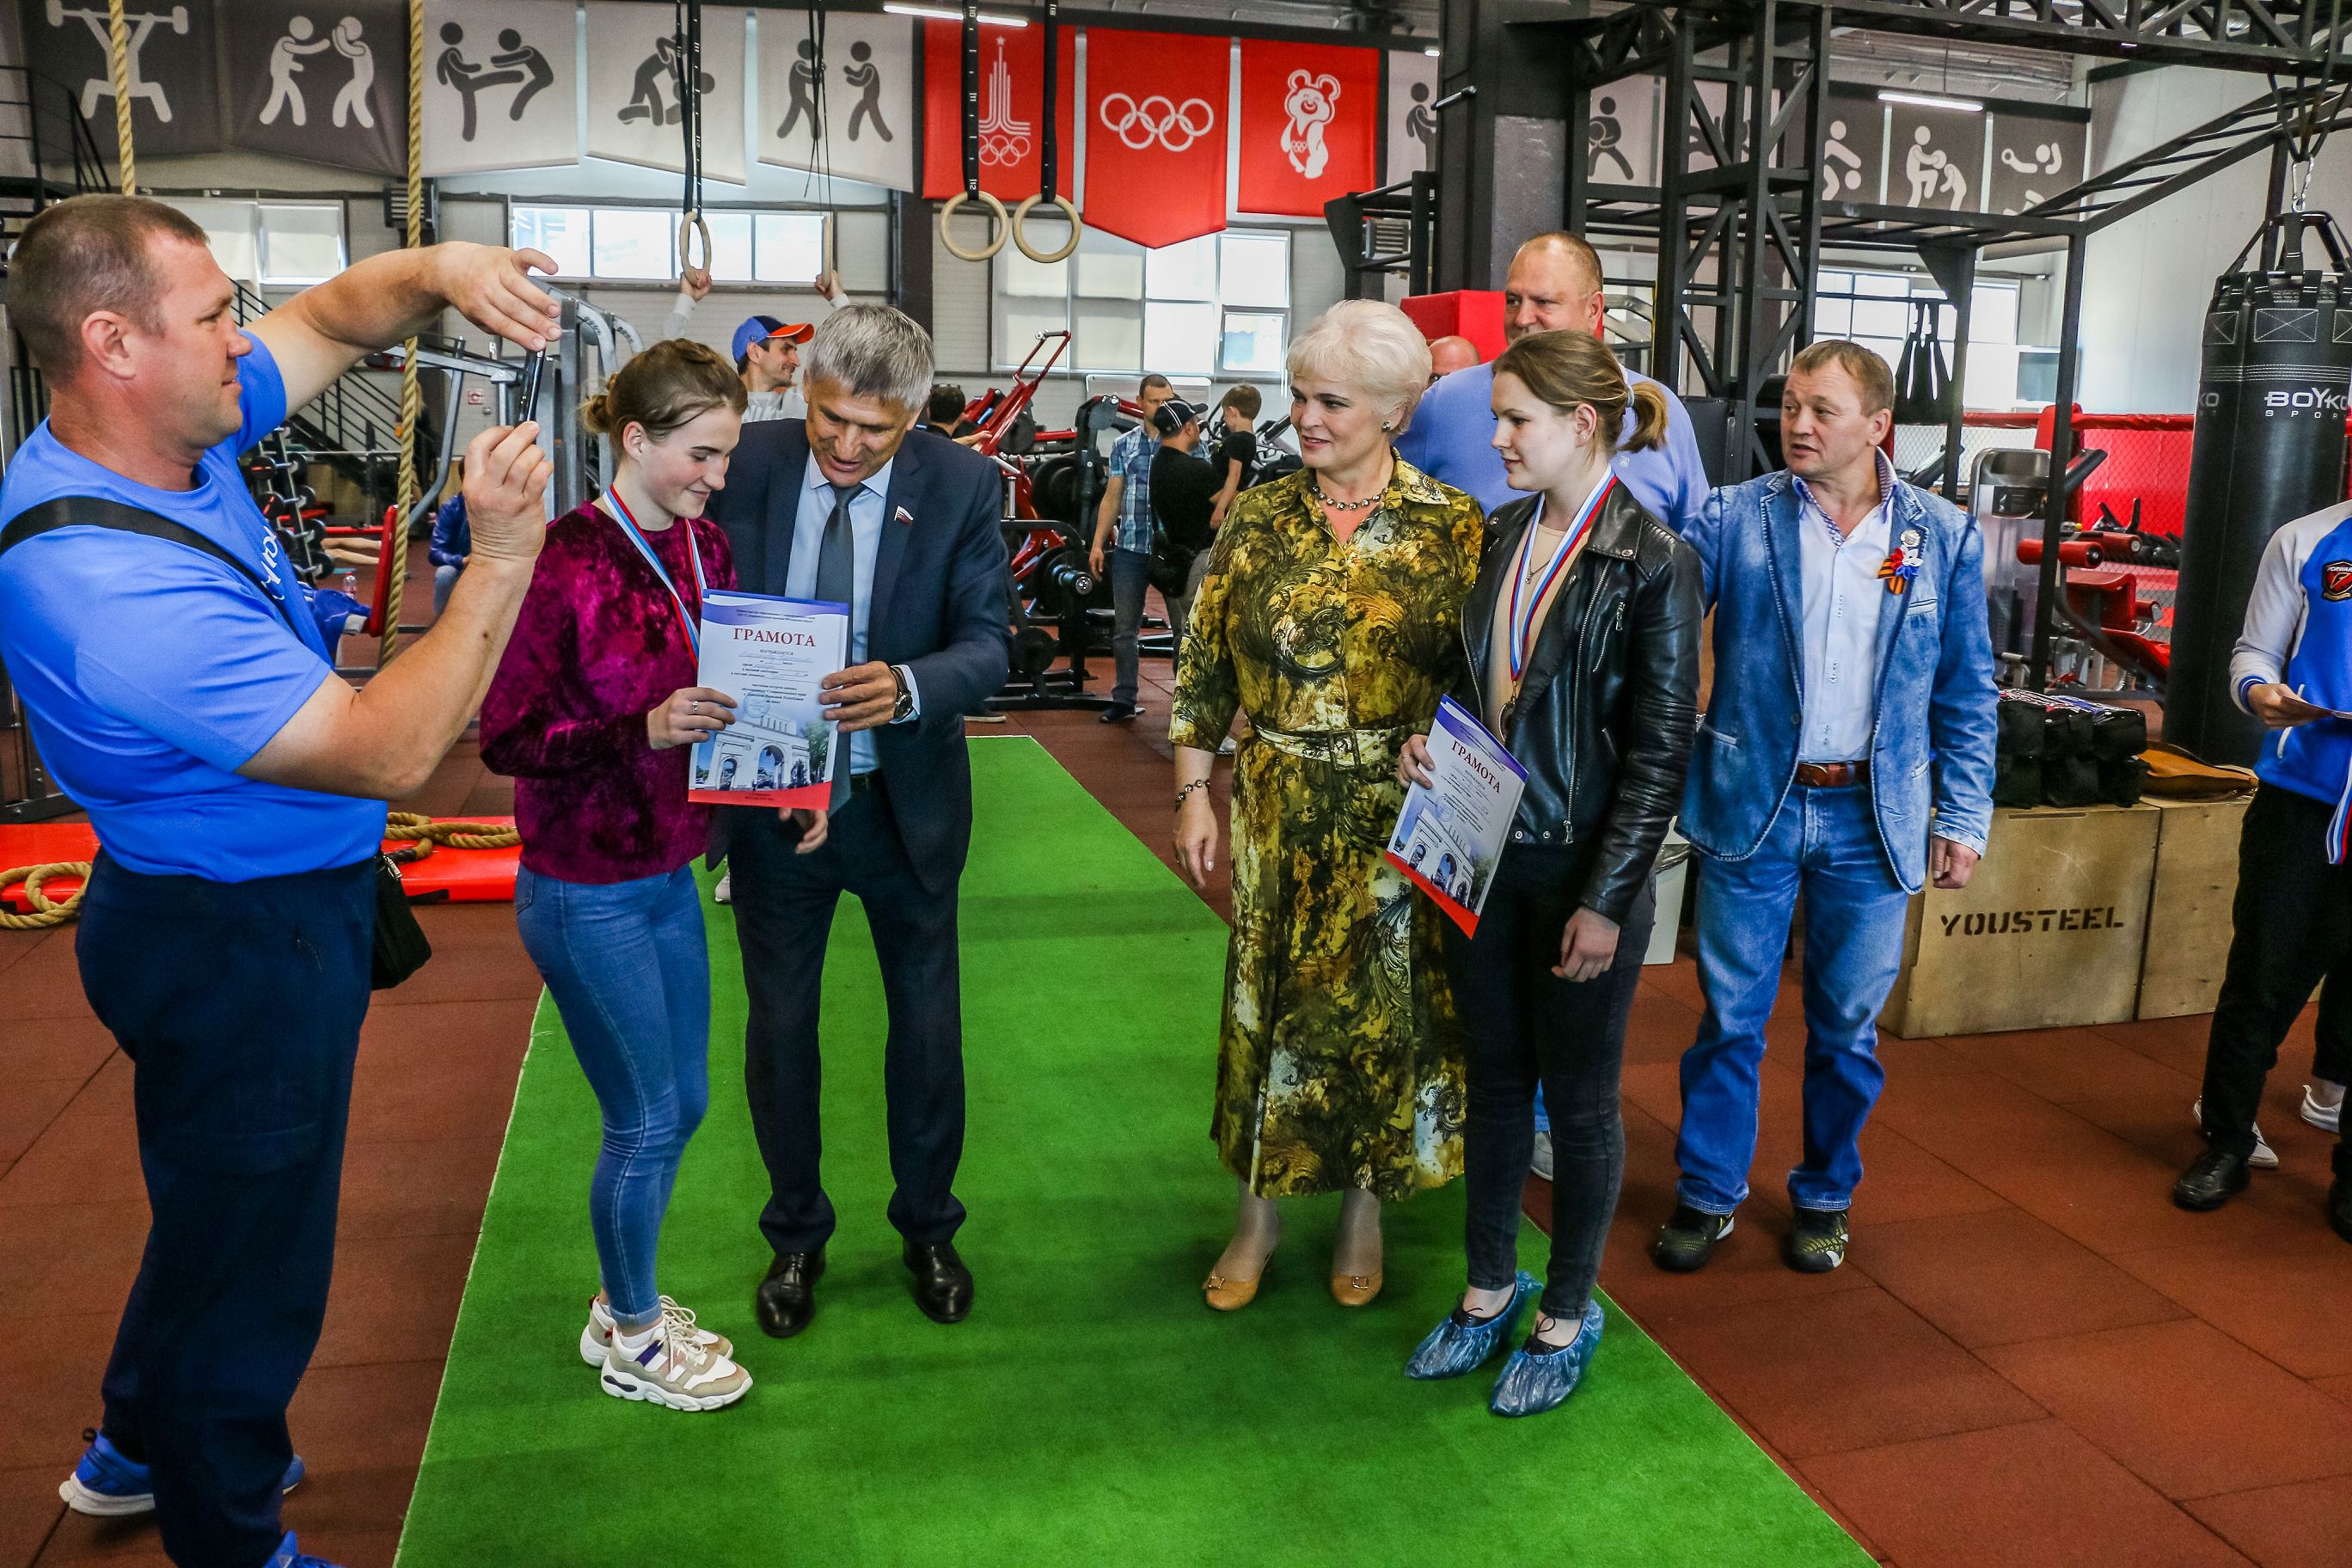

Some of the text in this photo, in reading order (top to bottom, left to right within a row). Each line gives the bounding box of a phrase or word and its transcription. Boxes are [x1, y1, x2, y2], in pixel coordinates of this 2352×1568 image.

[733, 628, 816, 647] ГРАМОТА
[1452, 739, 1500, 794] ГРАМОТА
[1940, 906, 2125, 937] YOUSTEEL
